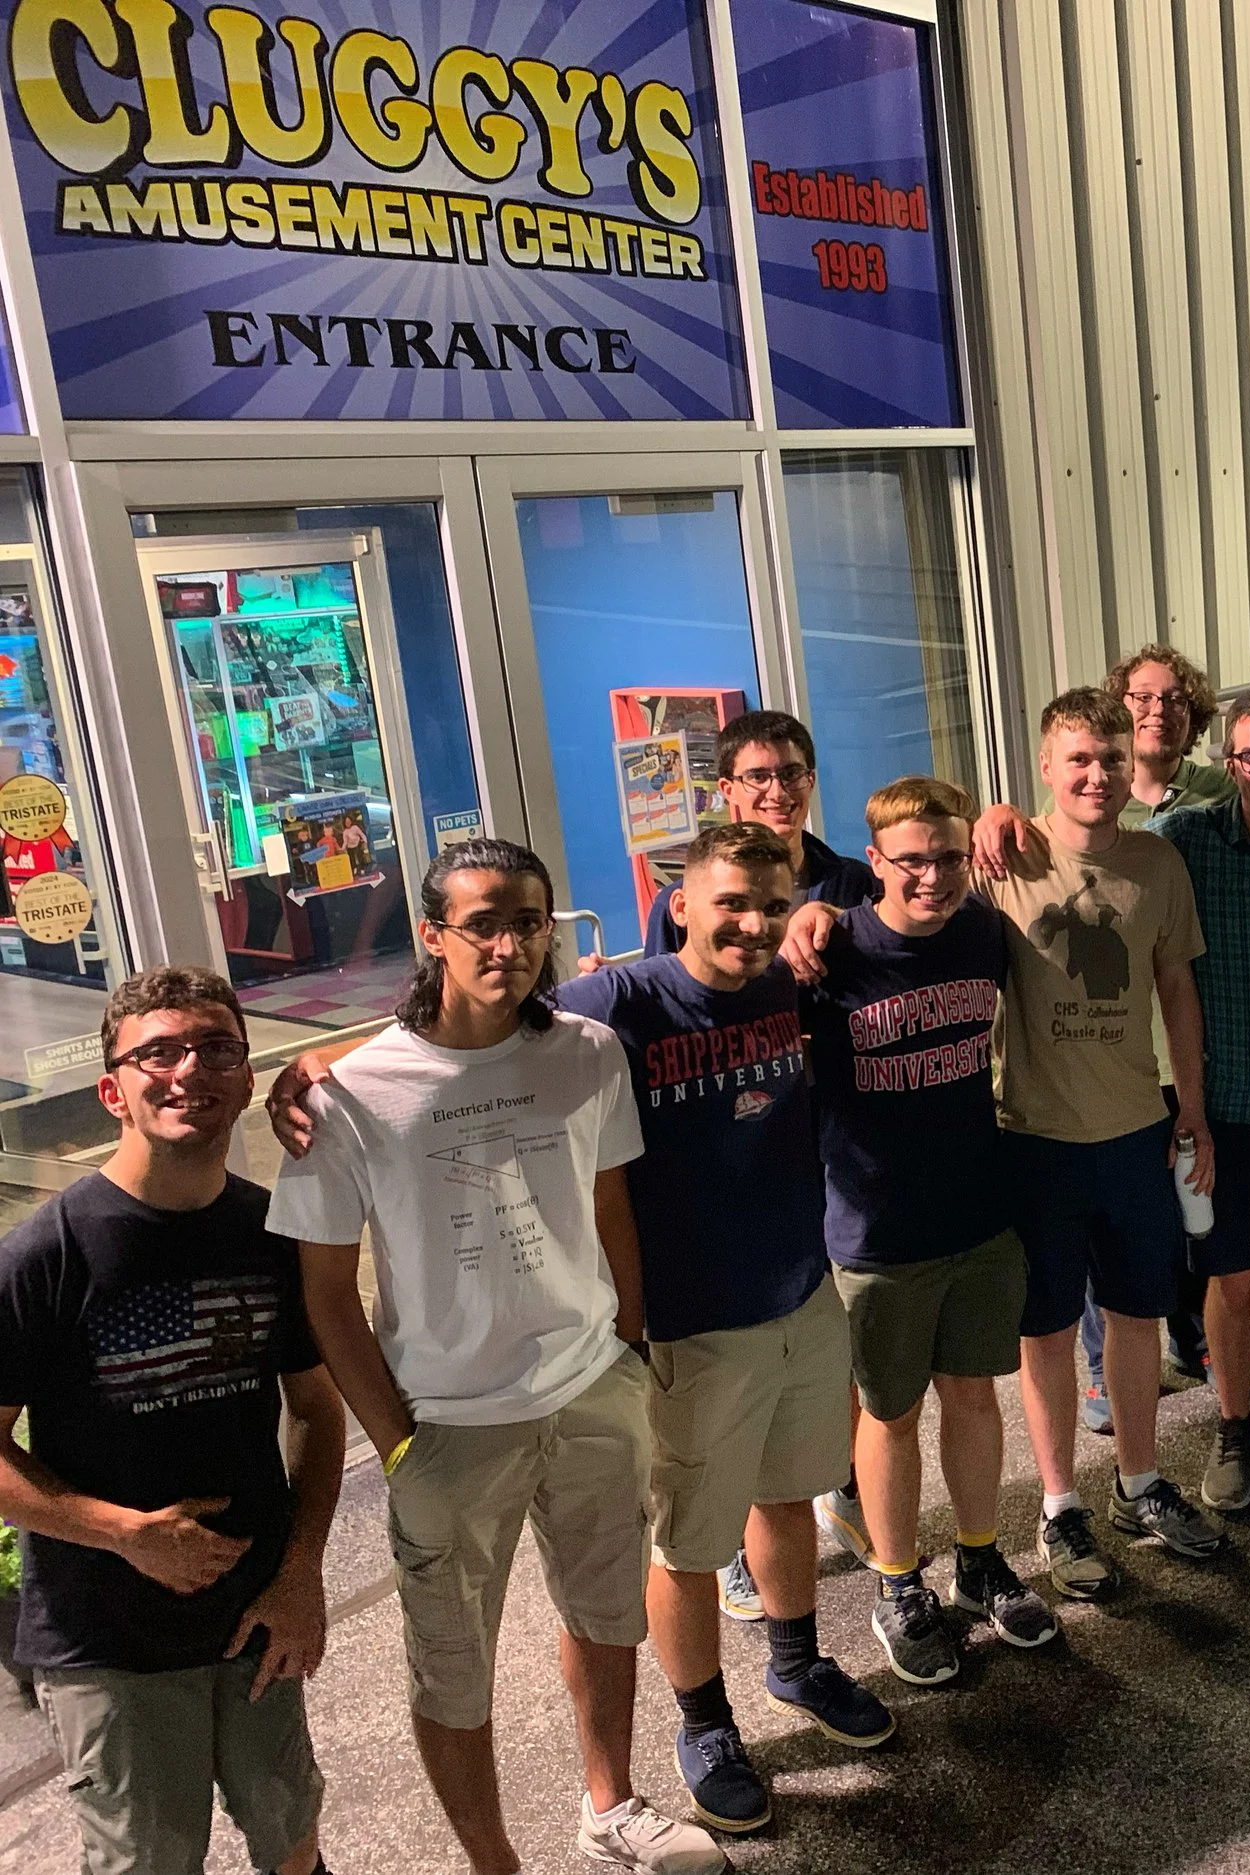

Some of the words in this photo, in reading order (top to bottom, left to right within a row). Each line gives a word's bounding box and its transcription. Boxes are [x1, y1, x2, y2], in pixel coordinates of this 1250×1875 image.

[9, 0, 702, 227] CLUGGY'S
[751, 160, 929, 233] Established
[55, 176, 494, 265] AMUSEMENT
[498, 198, 708, 281] CENTER
[811, 239, 889, 295] 1993
[204, 310, 637, 374] ENTRANCE
[632, 761, 657, 777] SPECIALS
[1, 802, 61, 822] TRISTATE
[440, 818, 453, 830] NO
[454, 814, 477, 827] PETS
[22, 901, 87, 923] TRISTATE
[1054, 1002, 1079, 1016] CHS
[1051, 1019, 1095, 1038] Classic
[46, 1041, 83, 1059] SHIRTS
[34, 1056, 70, 1072] SHOES
[854, 1030, 989, 1092] UNIVERSIT
[432, 1101, 494, 1123] Electrical
[496, 1093, 536, 1110] Power
[450, 1212, 472, 1221] Power
[495, 1204, 507, 1216] PF
[499, 1230, 506, 1239] S
[463, 1263, 480, 1272] (VA)
